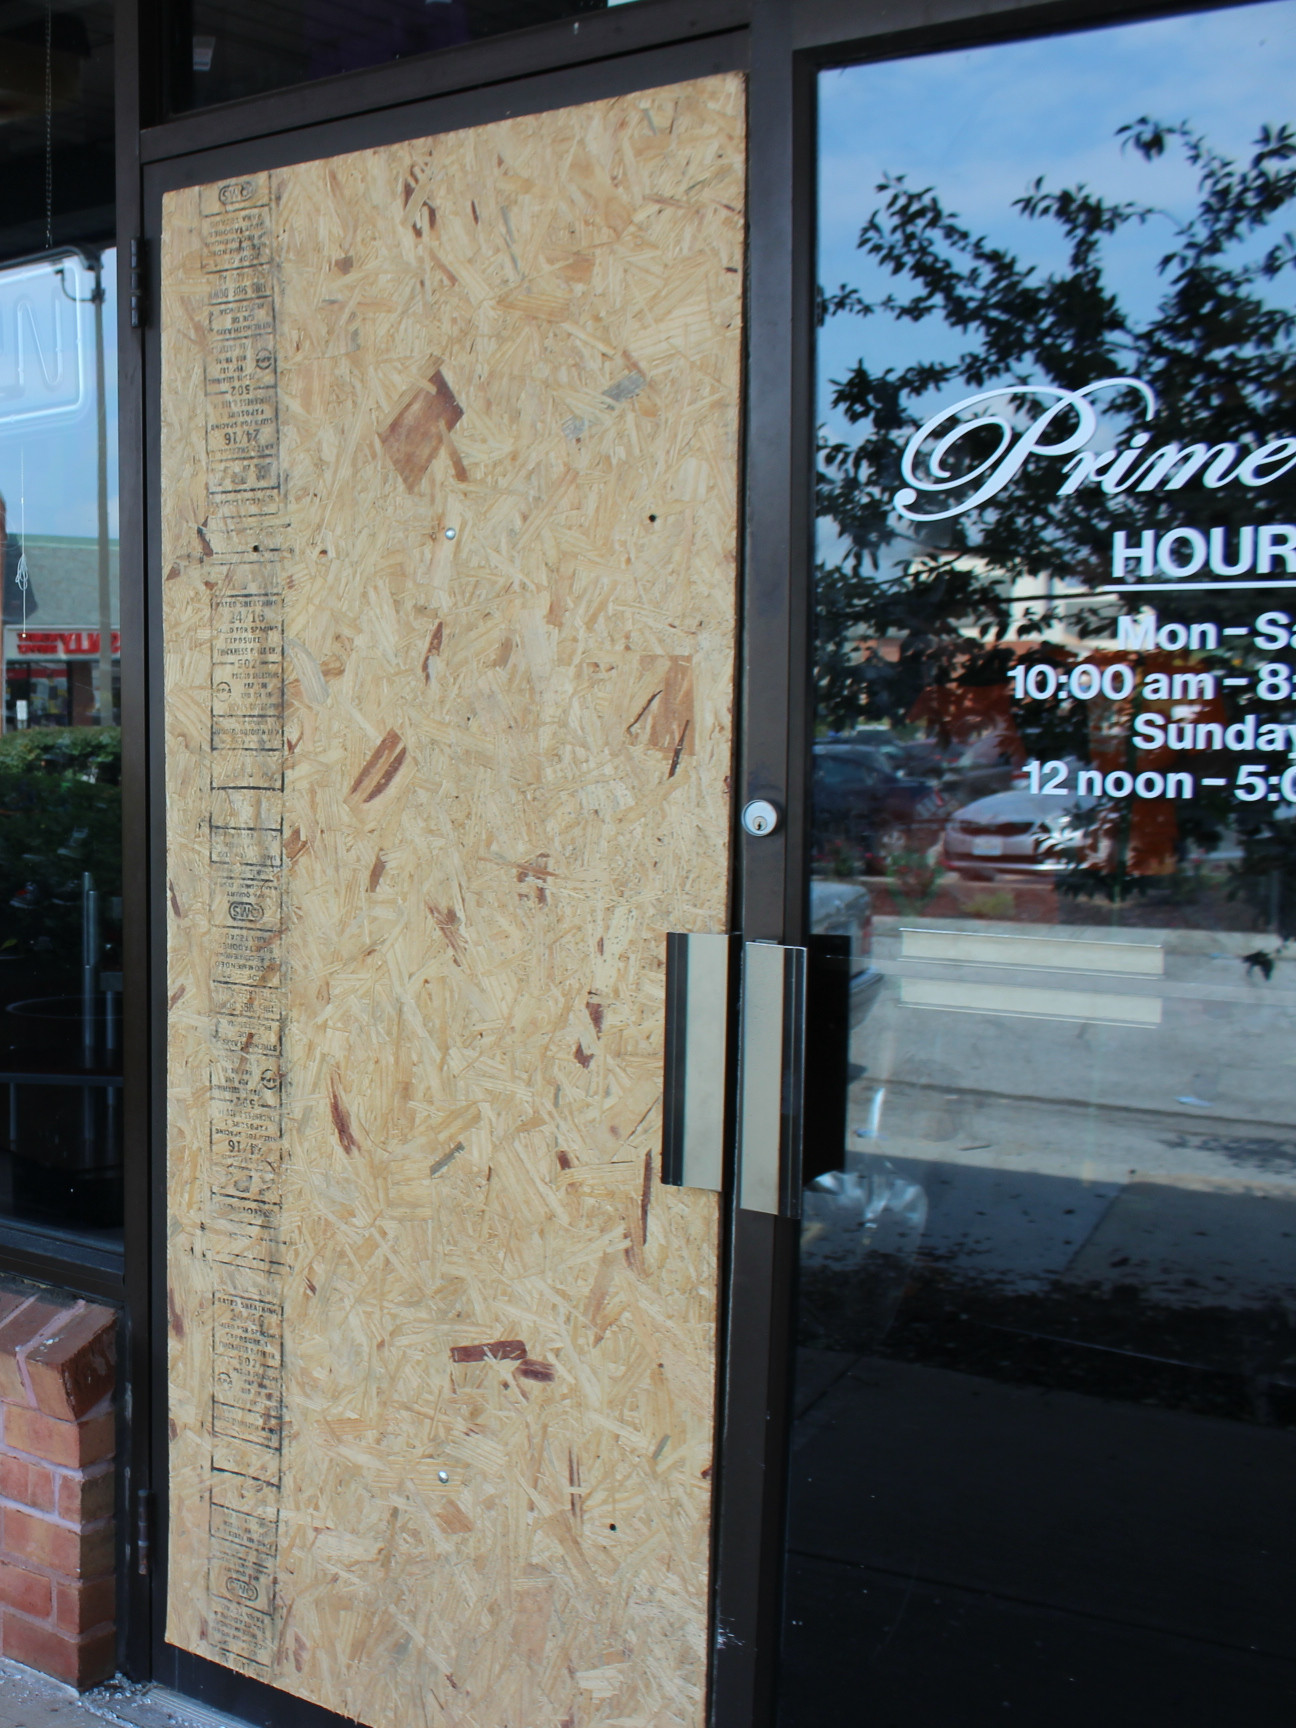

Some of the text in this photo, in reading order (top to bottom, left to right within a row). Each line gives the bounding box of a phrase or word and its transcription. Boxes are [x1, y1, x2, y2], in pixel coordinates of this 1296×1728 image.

[894, 377, 1296, 521] Prime
[1112, 524, 1296, 577] HOUR
[1007, 664, 1135, 700] 10:00
[1022, 760, 1069, 795] 12
